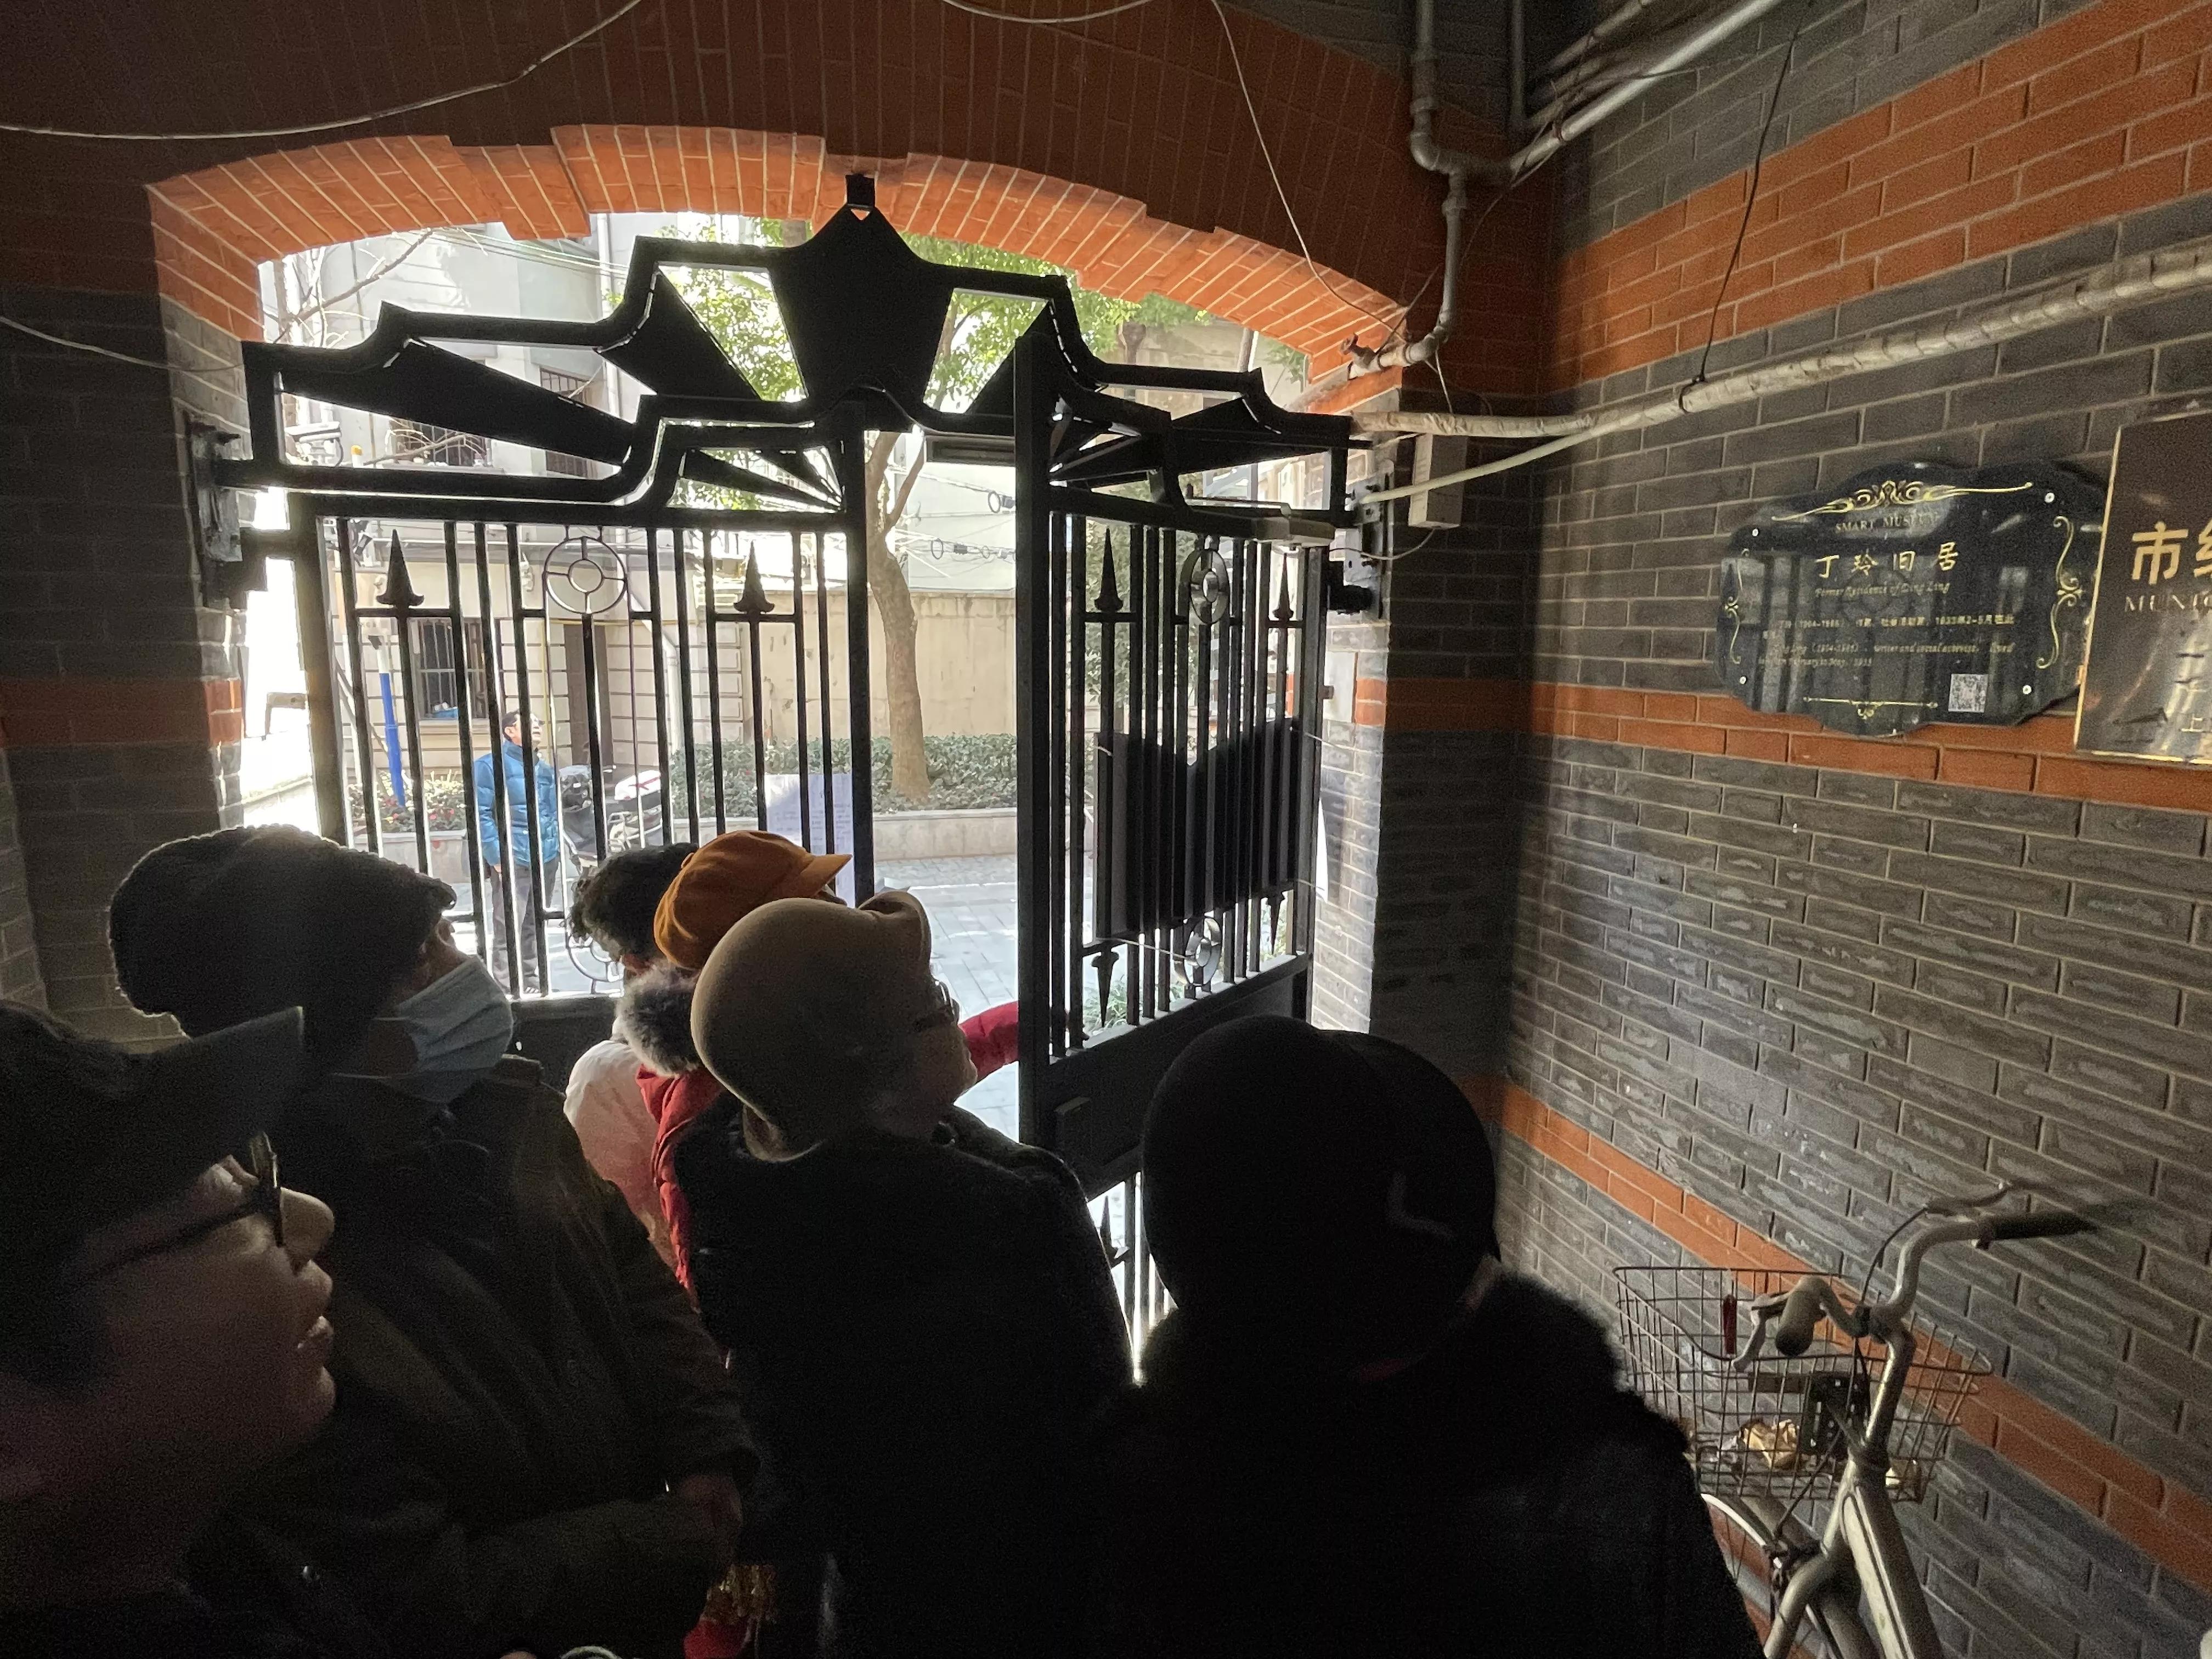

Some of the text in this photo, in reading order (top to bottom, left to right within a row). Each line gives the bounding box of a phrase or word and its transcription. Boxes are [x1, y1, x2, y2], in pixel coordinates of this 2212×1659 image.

[1836, 519, 1876, 533] SMART
[1815, 541, 1959, 578] 丁玲旧居
